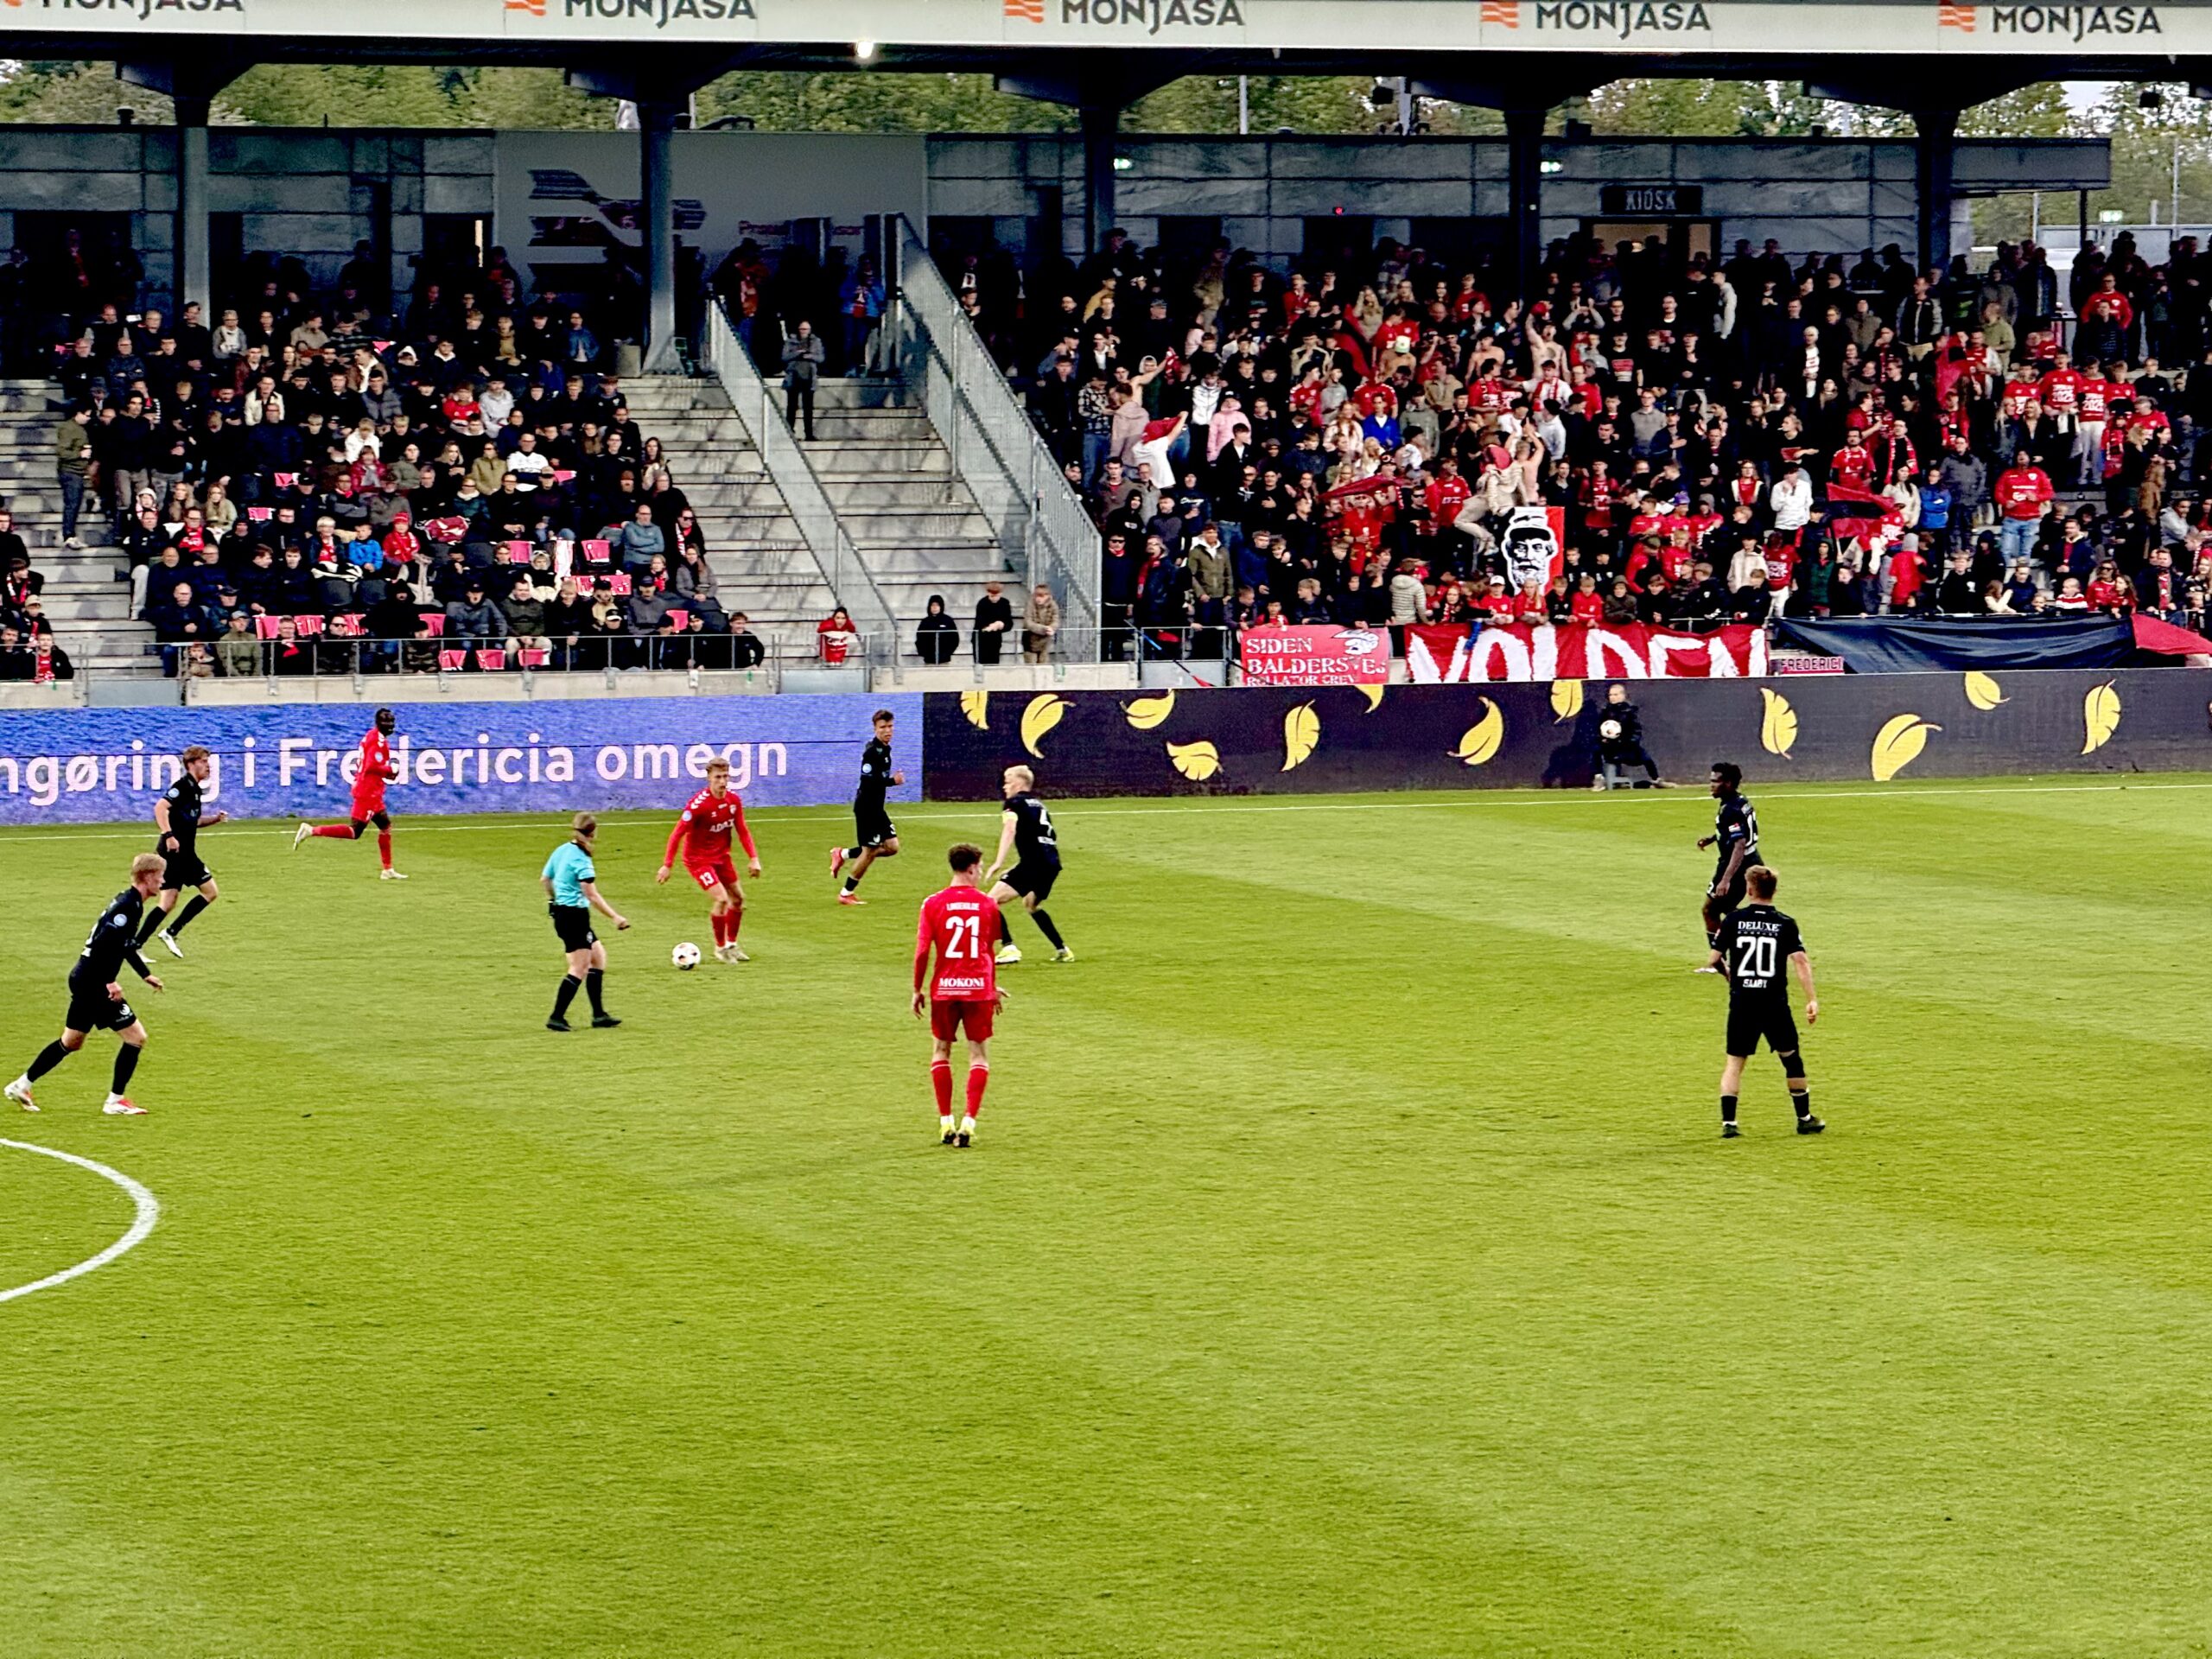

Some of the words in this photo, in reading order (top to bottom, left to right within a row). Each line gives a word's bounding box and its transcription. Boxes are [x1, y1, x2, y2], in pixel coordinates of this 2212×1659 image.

[565, 0, 757, 29] MONJASA
[1062, 0, 1244, 35] MONJASA
[1536, 2, 1711, 40] MONJASA
[1993, 5, 2162, 43] MONJASA
[1246, 637, 1313, 654] SIDEN
[243, 736, 256, 787] i
[279, 733, 575, 787] Fredericia
[595, 741, 787, 790] omegn
[944, 915, 980, 958] 21
[1737, 920, 1780, 932] DELUXE
[1736, 936, 1777, 977] 20
